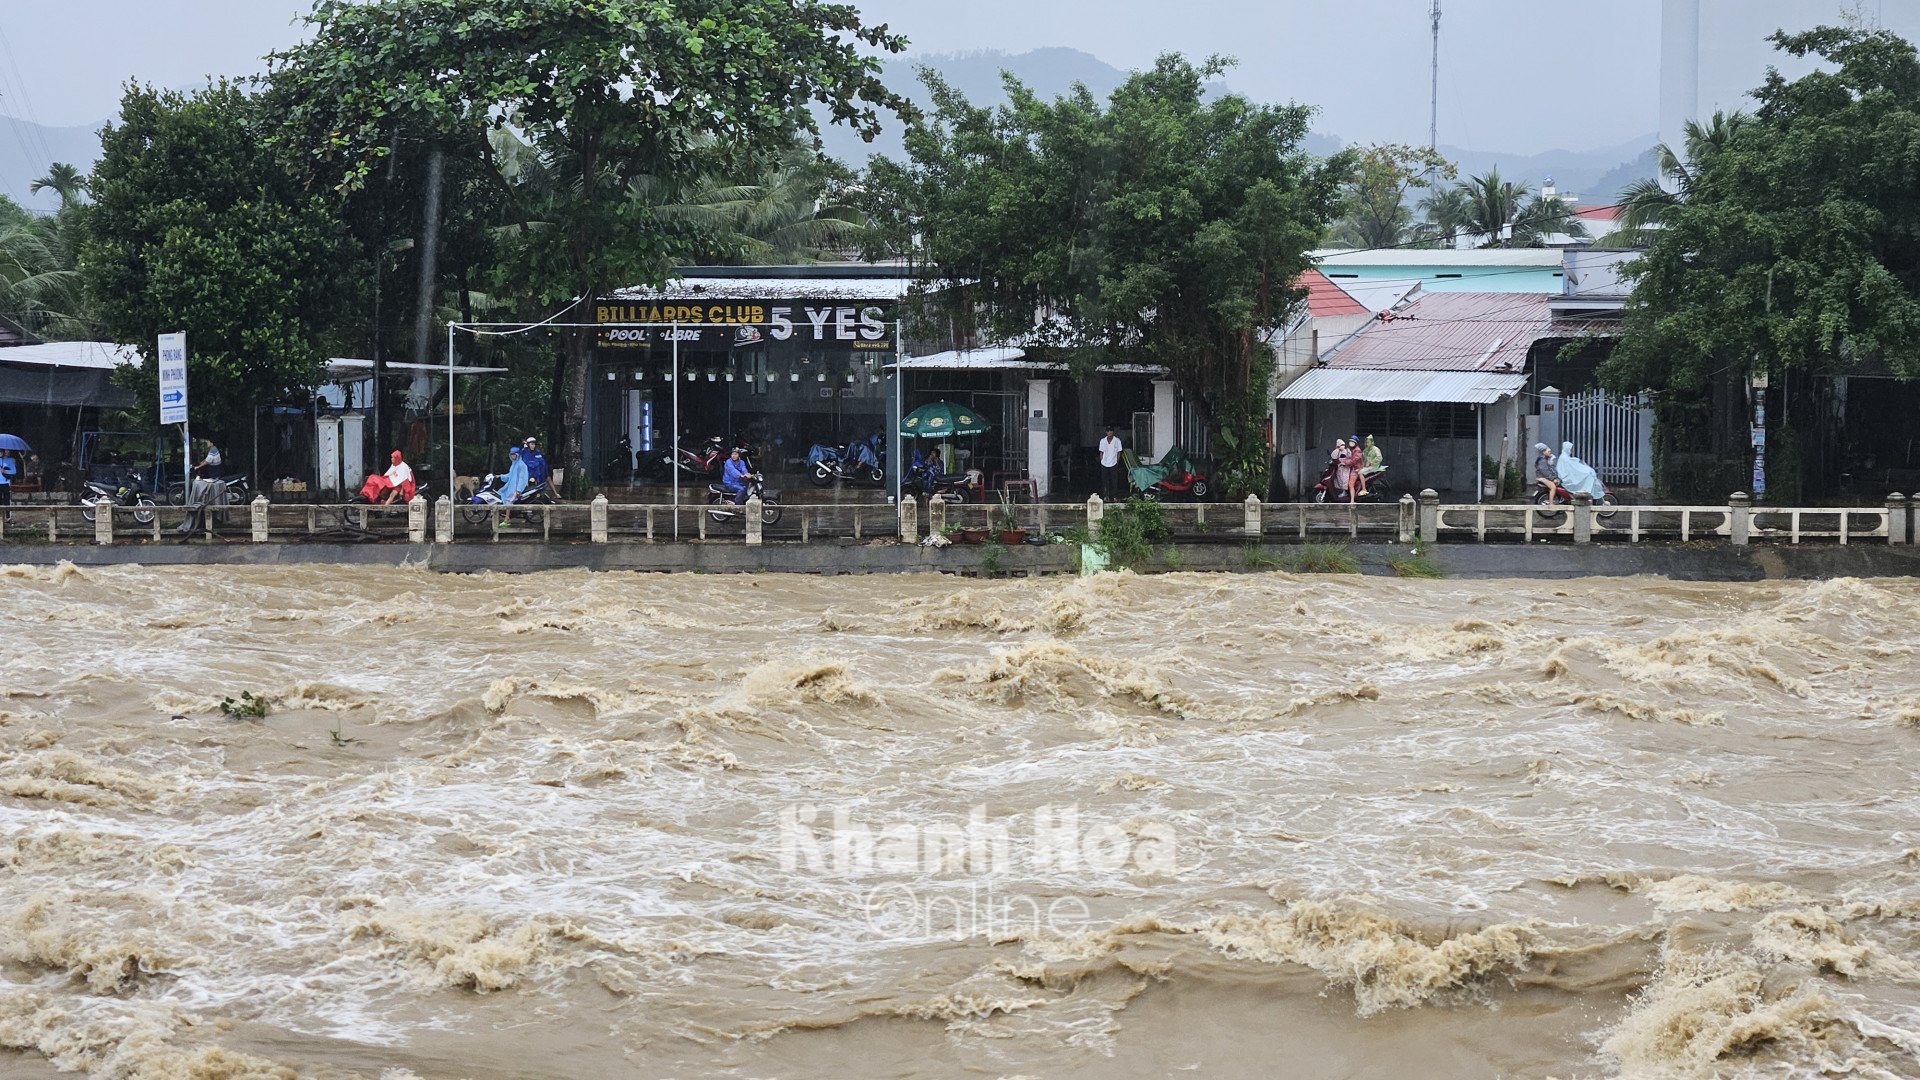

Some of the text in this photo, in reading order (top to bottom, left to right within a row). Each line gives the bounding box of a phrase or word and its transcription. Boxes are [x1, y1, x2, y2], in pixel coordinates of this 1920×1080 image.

[597, 306, 764, 323] BILLIARDS CLUB
[771, 306, 885, 340] 5 YES
[609, 329, 702, 341] POOL LBRE
